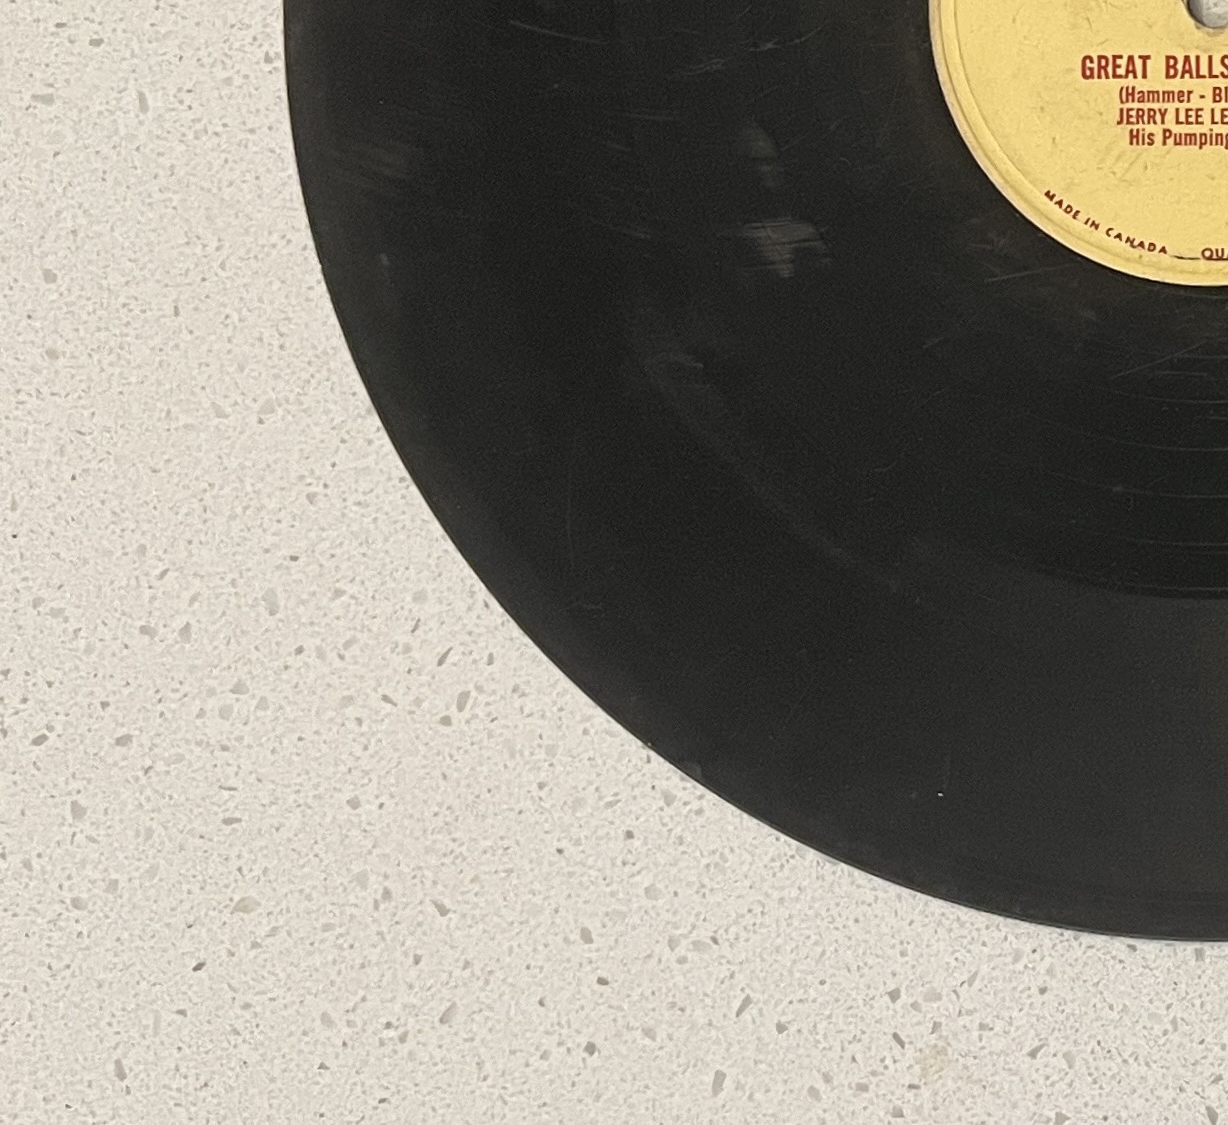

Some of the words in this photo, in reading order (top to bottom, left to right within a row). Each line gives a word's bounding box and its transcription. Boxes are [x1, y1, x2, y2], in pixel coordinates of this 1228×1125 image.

[1080, 54, 1152, 81] GREAT
[1118, 85, 1194, 105] (Hammer
[1116, 107, 1169, 126] JERRY
[1174, 107, 1205, 126] LEE
[1128, 127, 1156, 147] His
[1044, 190, 1081, 220] MADE
[1083, 217, 1100, 230] IN
[1105, 227, 1168, 255] CANADA
